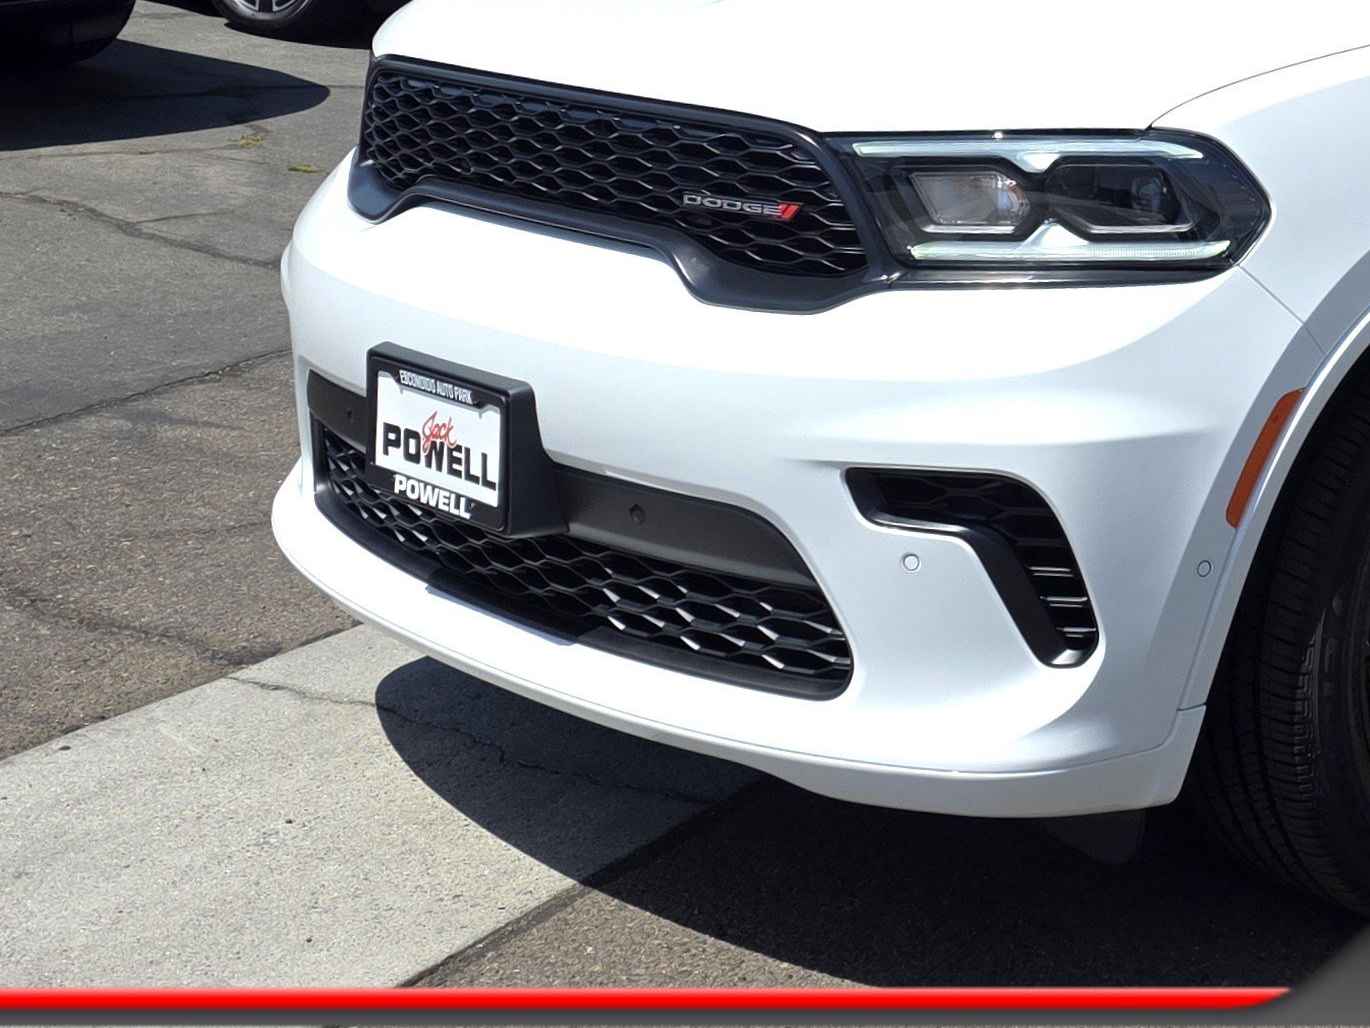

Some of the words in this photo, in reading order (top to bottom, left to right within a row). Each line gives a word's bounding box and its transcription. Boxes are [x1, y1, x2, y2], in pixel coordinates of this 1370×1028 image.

[682, 194, 783, 216] DODGE
[399, 370, 436, 394] ESCONDIDO
[436, 380, 454, 399] AUTO
[454, 386, 474, 405] PARK
[422, 410, 457, 454] Jack
[382, 422, 497, 492] POWELL
[393, 474, 472, 519] POWELL
